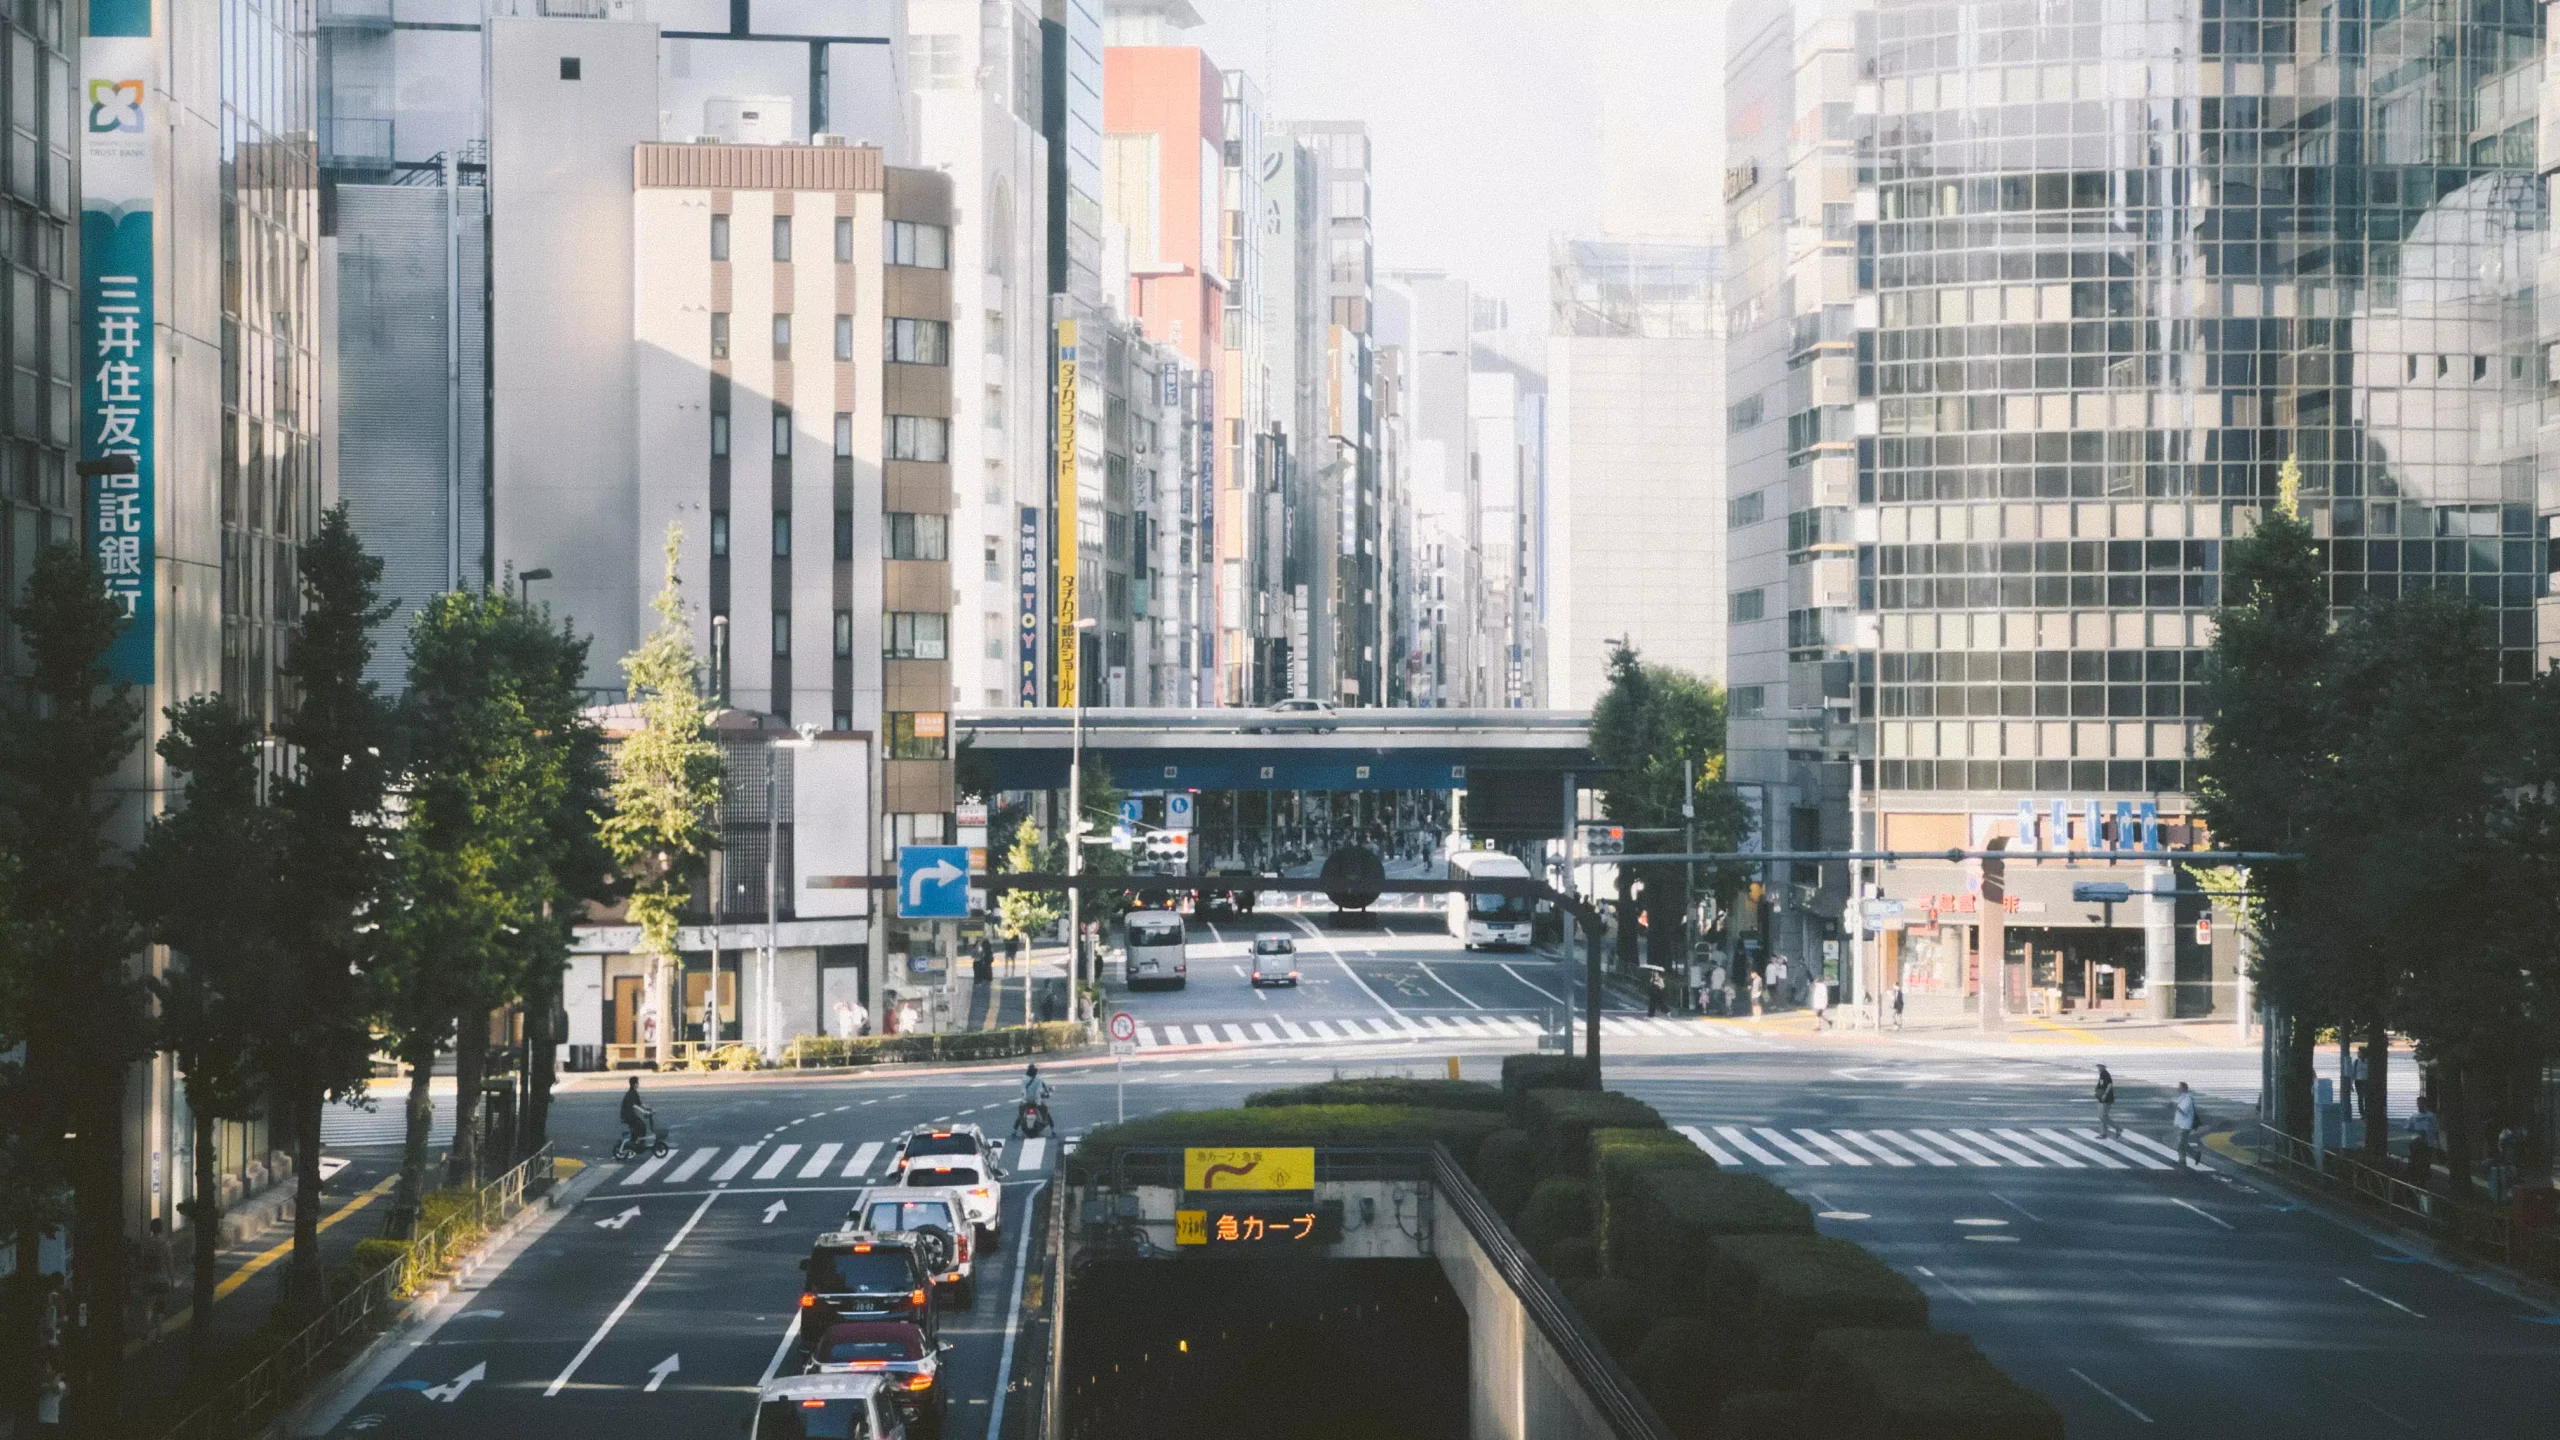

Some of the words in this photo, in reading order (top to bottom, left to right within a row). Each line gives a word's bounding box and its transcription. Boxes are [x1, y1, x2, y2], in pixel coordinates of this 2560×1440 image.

[1022, 593, 1036, 649] TOY
[1216, 1213, 1316, 1241] 急カーブ
